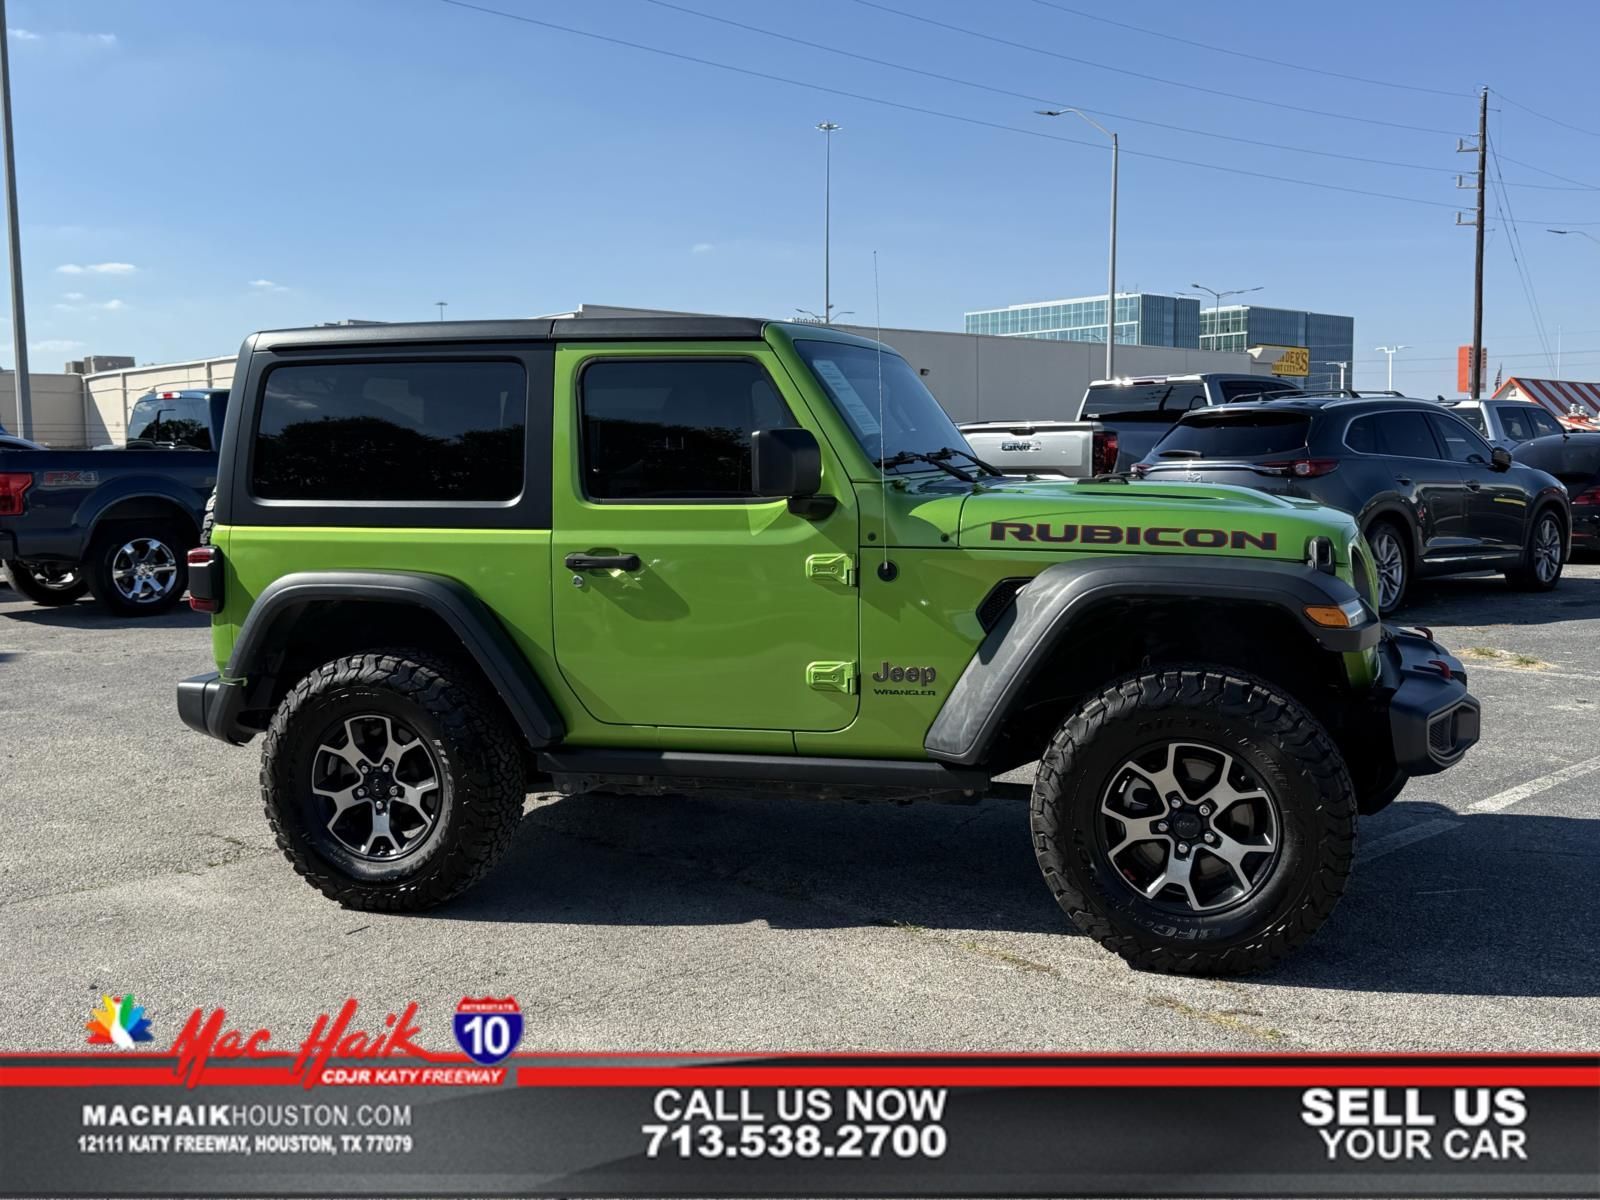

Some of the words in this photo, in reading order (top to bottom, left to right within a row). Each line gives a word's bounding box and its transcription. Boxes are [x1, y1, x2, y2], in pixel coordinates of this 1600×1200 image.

[44, 470, 98, 486] FX4
[990, 521, 1277, 551] RUBICON
[872, 661, 937, 687] Jeep
[873, 688, 936, 696] WRANGLER
